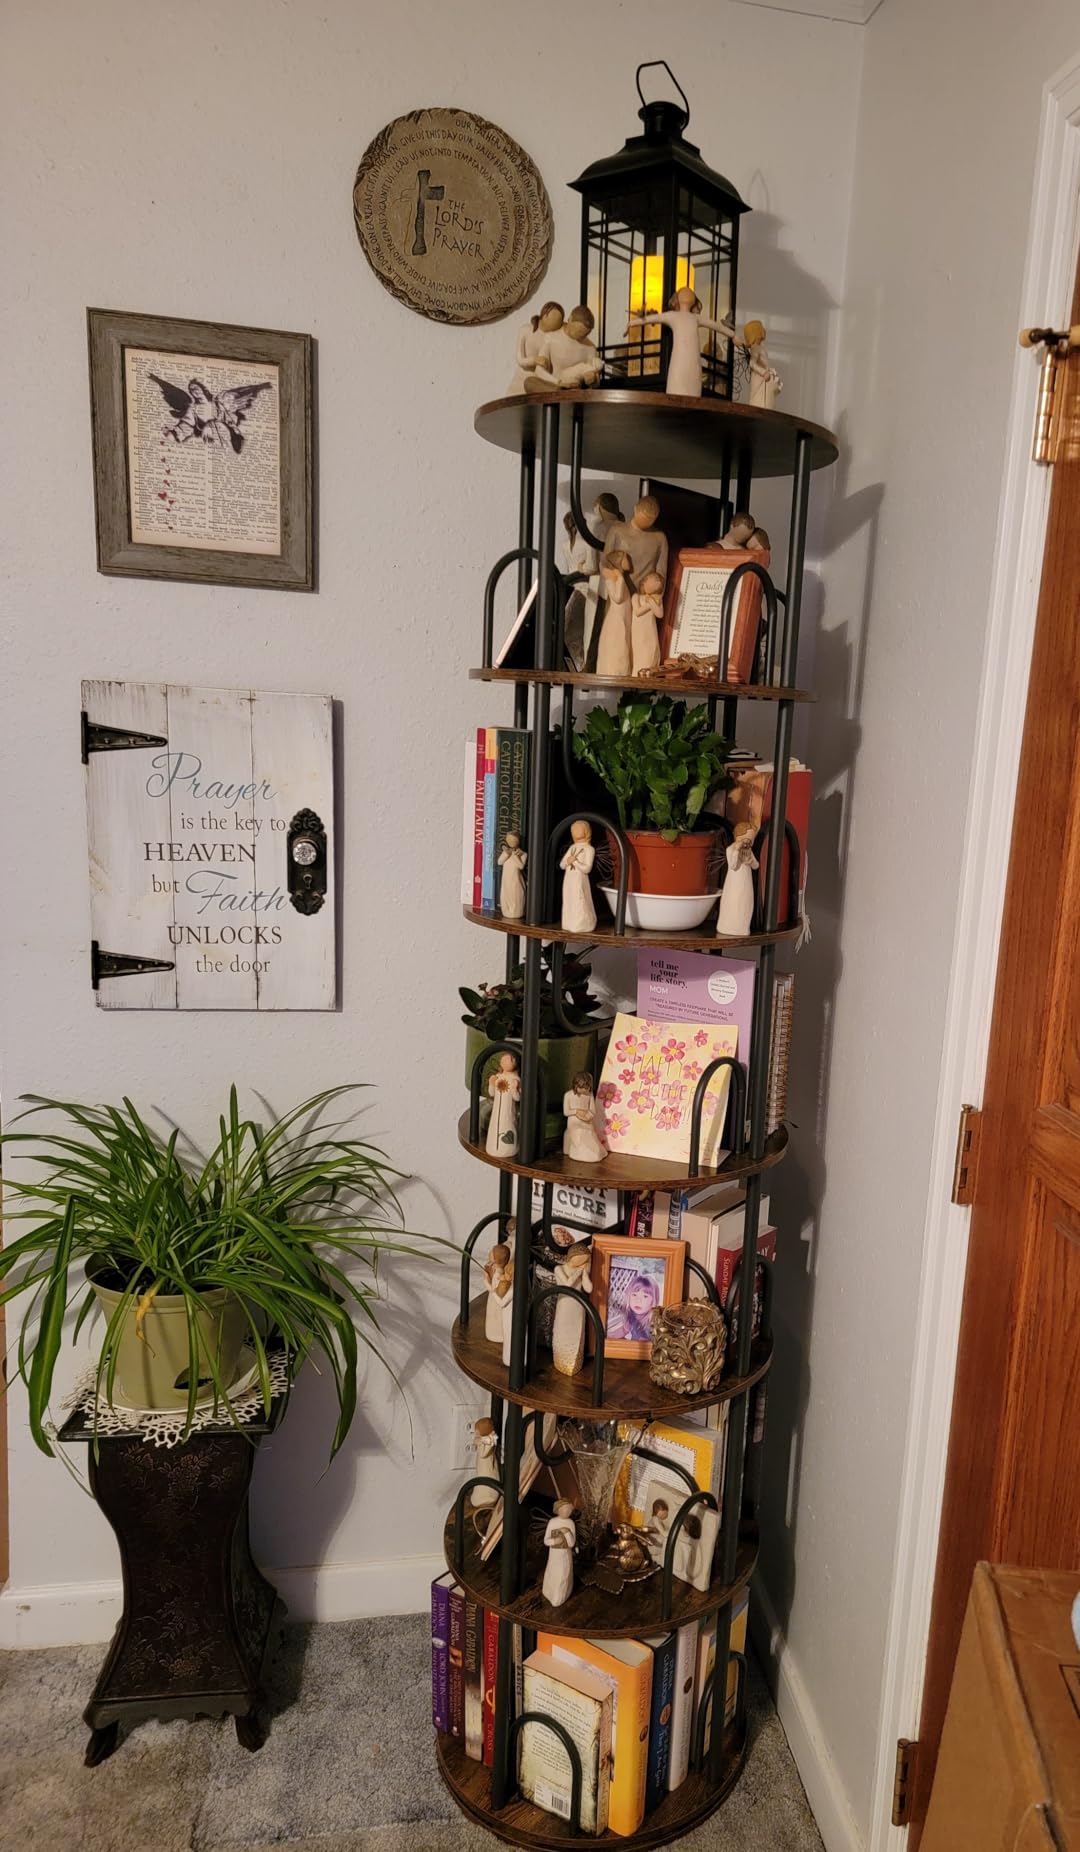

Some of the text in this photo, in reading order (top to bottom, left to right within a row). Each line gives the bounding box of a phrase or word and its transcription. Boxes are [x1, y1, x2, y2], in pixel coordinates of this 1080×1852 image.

[400, 133, 416, 147] GIVE
[415, 131, 425, 141] US
[425, 129, 440, 140] THIS
[441, 129, 458, 141] DAY
[456, 119, 472, 131] OUR
[502, 145, 518, 163] WHO
[459, 132, 474, 148] OUR
[475, 142, 497, 161] DAILY
[392, 157, 410, 174] LEAD
[409, 150, 419, 161] US
[510, 184, 521, 203] AND
[449, 199, 465, 213] THE
[435, 205, 484, 235] LORD'S
[433, 227, 485, 261] PRAYER
[393, 250, 409, 270] WHO
[406, 266, 427, 285] THOSE
[427, 279, 457, 295] FORGIVE
[459, 286, 472, 296] WE
[146, 752, 277, 809] Prayer
[499, 740, 511, 804] CATHOLIC
[512, 741, 524, 812] CATECHISM
[181, 811, 286, 837] is the key to
[144, 842, 256, 863] HEAVEN
[152, 870, 287, 915] but Faith
[167, 925, 282, 945] UNLOCKS
[196, 955, 271, 974] the door
[650, 960, 680, 971] tell me
[659, 969, 679, 978] your
[649, 985, 668, 994] MOM
[650, 973, 688, 989] life story.
[557, 1189, 607, 1217] CURE
[722, 1257, 731, 1284] SUNDAY
[466, 1601, 477, 1628] DIANA
[464, 1630, 477, 1673] GABALDON
